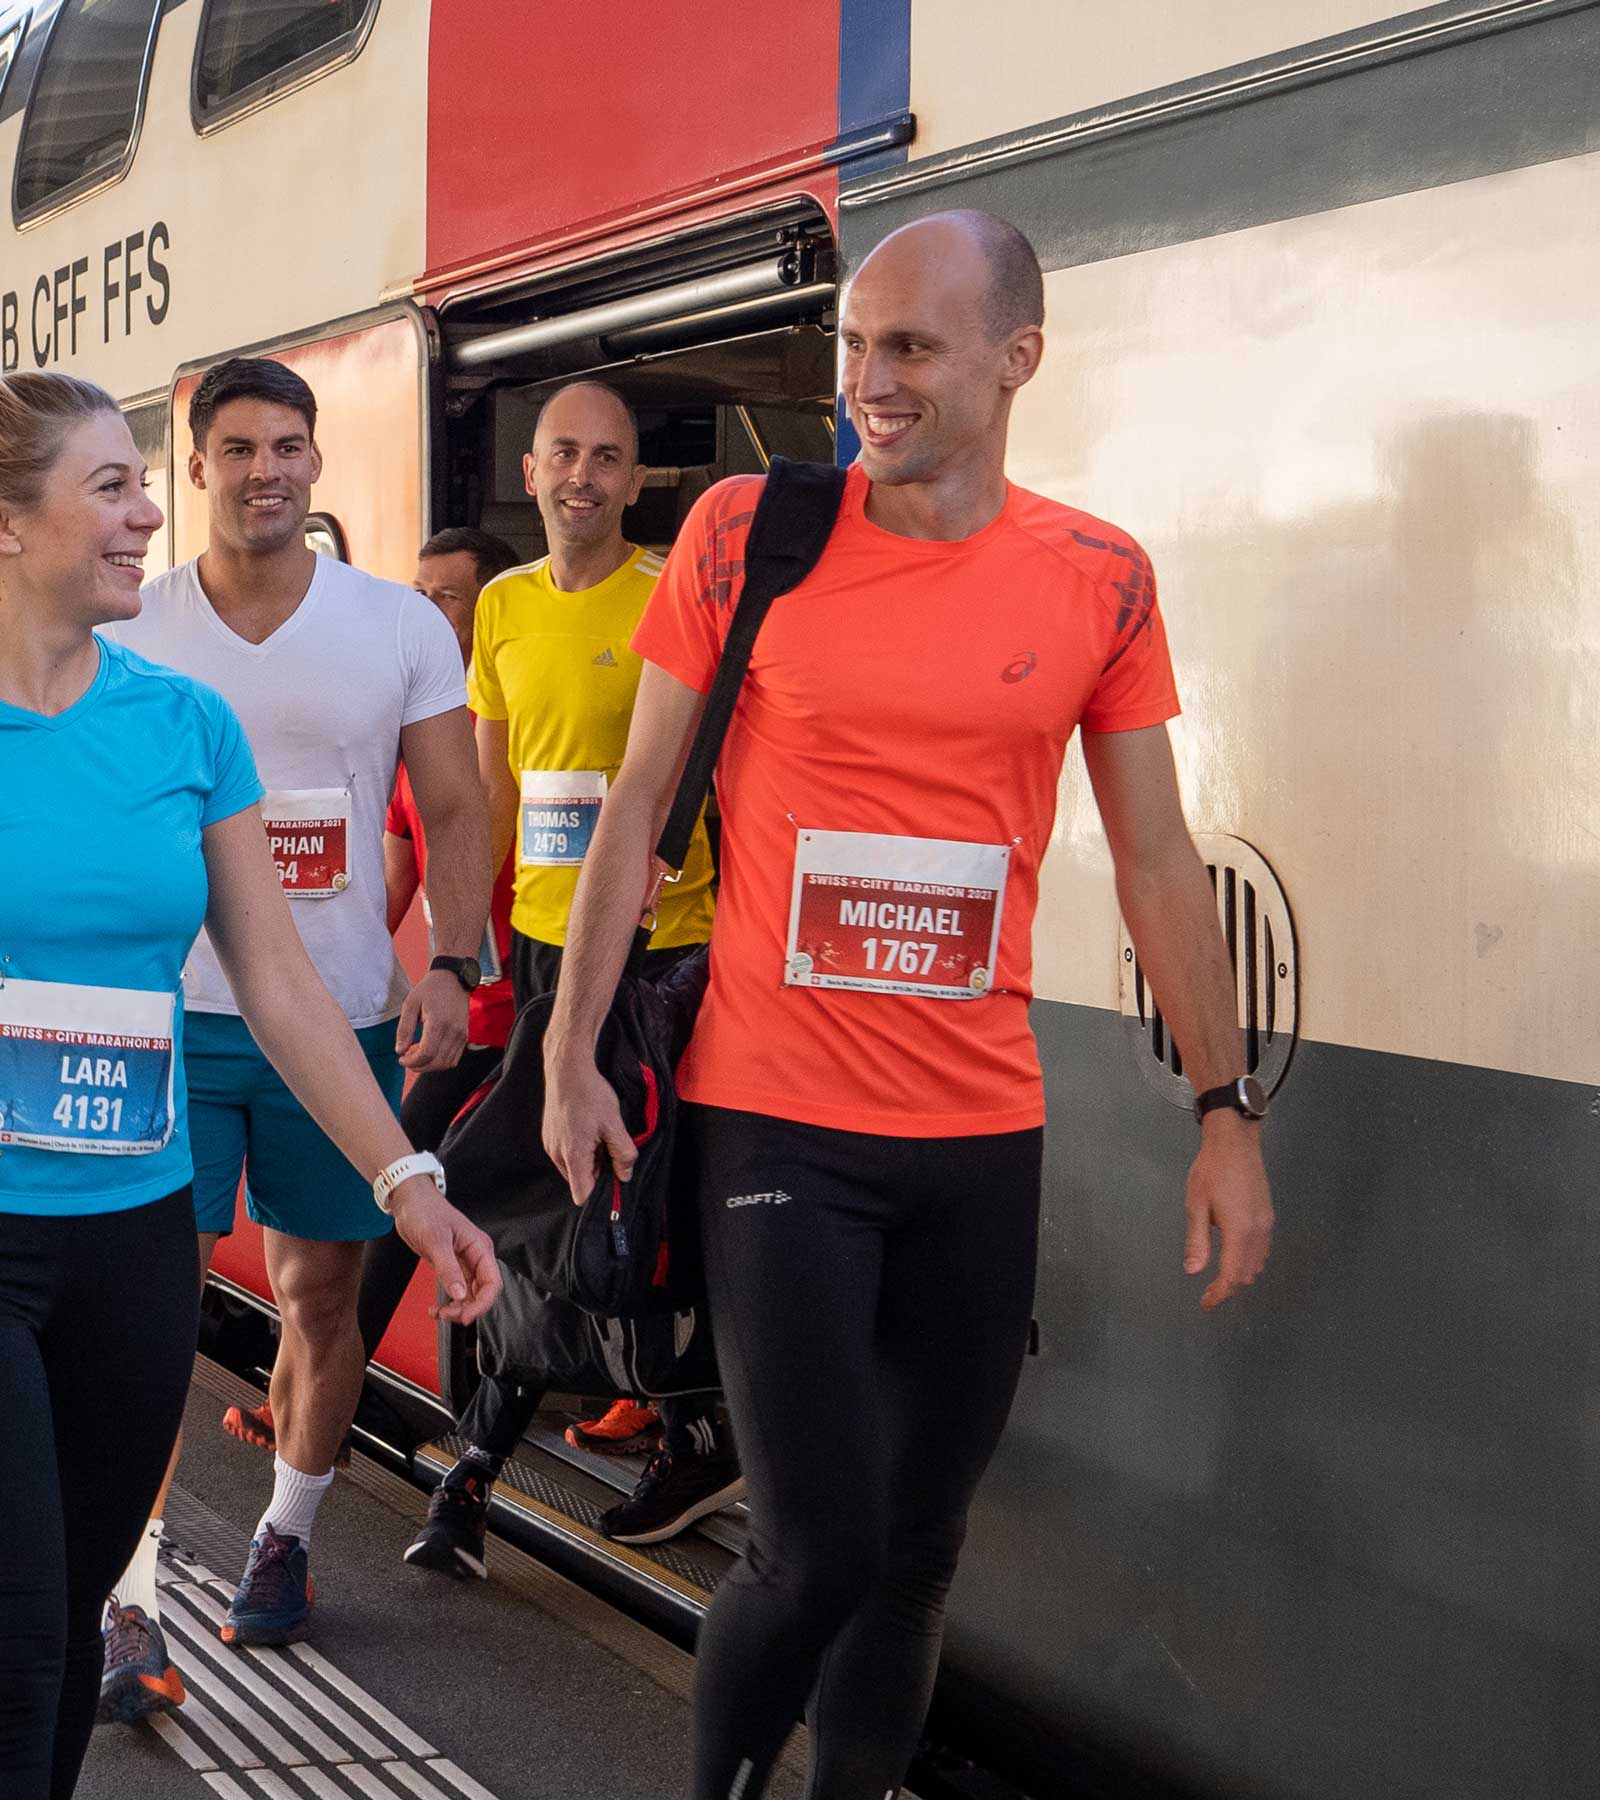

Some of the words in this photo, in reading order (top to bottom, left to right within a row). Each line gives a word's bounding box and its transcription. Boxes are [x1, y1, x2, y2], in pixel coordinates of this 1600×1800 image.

[32, 256, 89, 368] CFF
[104, 221, 170, 344] FFS
[272, 820, 321, 829] MARATHON
[323, 819, 341, 828] 2021
[528, 811, 580, 828] THOMAS
[267, 835, 324, 855] PHAN
[534, 832, 568, 853] 2479
[808, 874, 849, 888] SWISS
[860, 878, 890, 891] CITY
[893, 881, 964, 898] MARATHON
[967, 888, 993, 901] 2021
[839, 899, 965, 937] MICHAEL
[861, 937, 938, 976] 1767
[2, 1025, 44, 1040] SWISS
[55, 1031, 85, 1044] CITY
[86, 1033, 150, 1050] MARATHON
[60, 1055, 128, 1089] LARA
[52, 1094, 124, 1133] 4131
[726, 1193, 775, 1208] CRAFT
